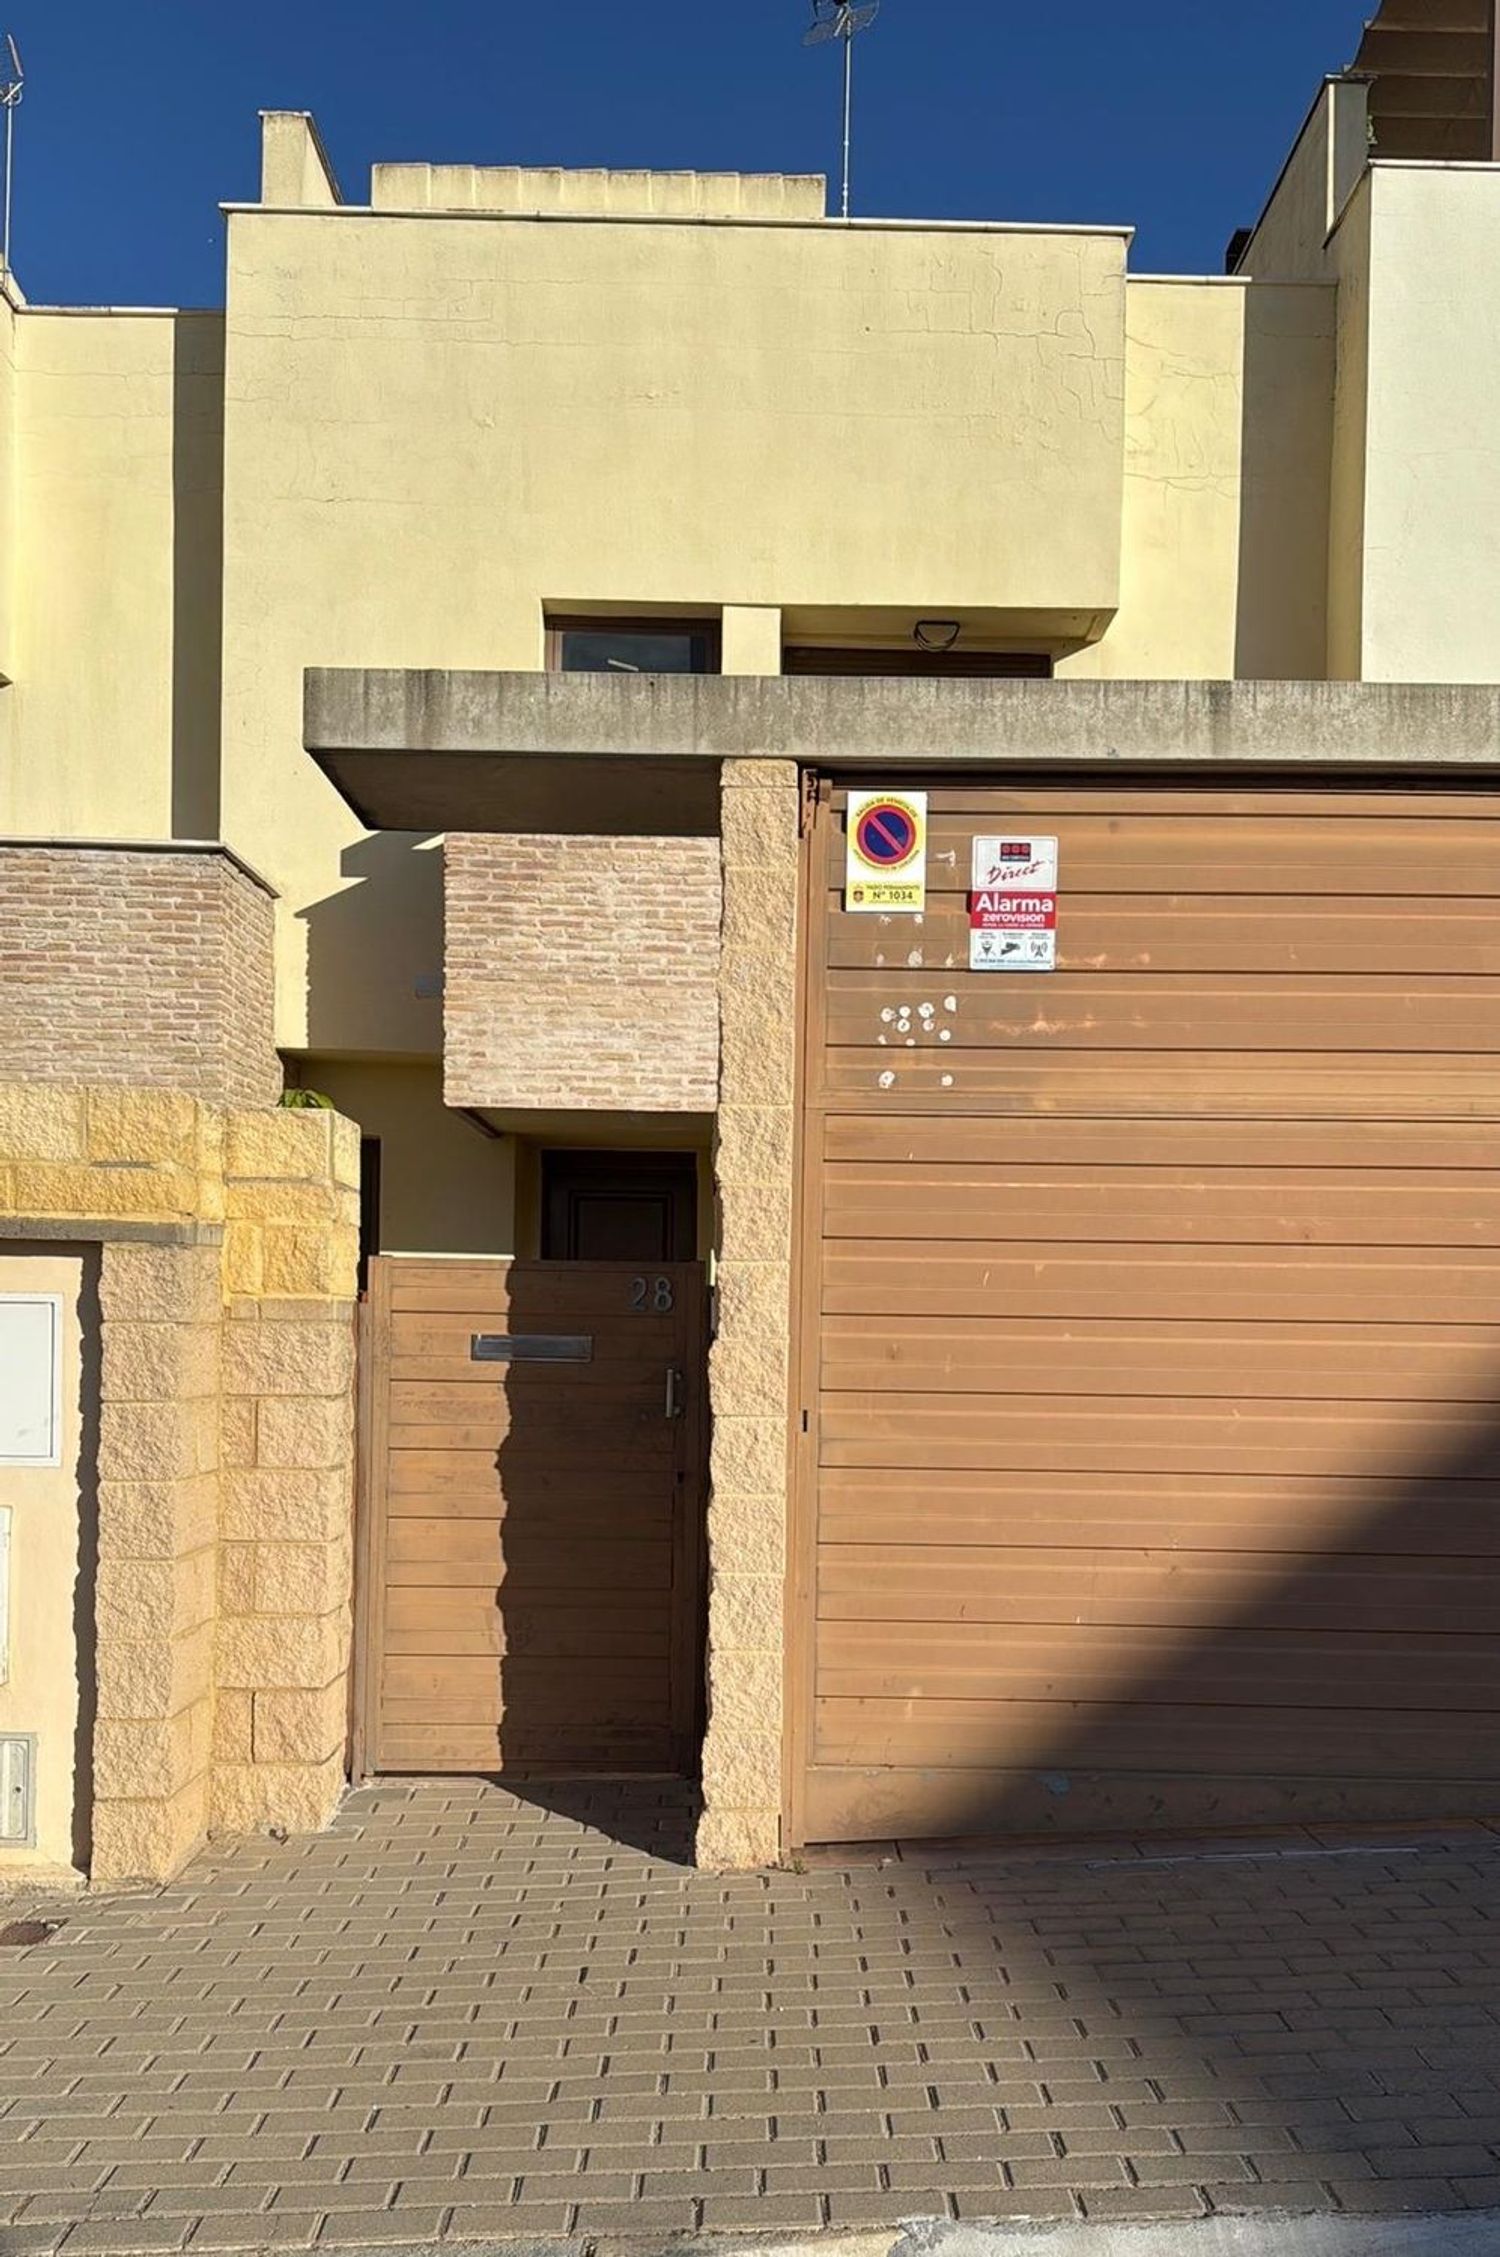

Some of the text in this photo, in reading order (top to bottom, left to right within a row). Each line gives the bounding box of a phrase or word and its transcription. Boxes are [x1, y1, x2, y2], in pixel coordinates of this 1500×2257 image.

[987, 860, 1044, 884] Direct
[889, 890, 914, 900] 1034
[975, 892, 1054, 912] Alarma
[630, 1277, 673, 1312] 28
